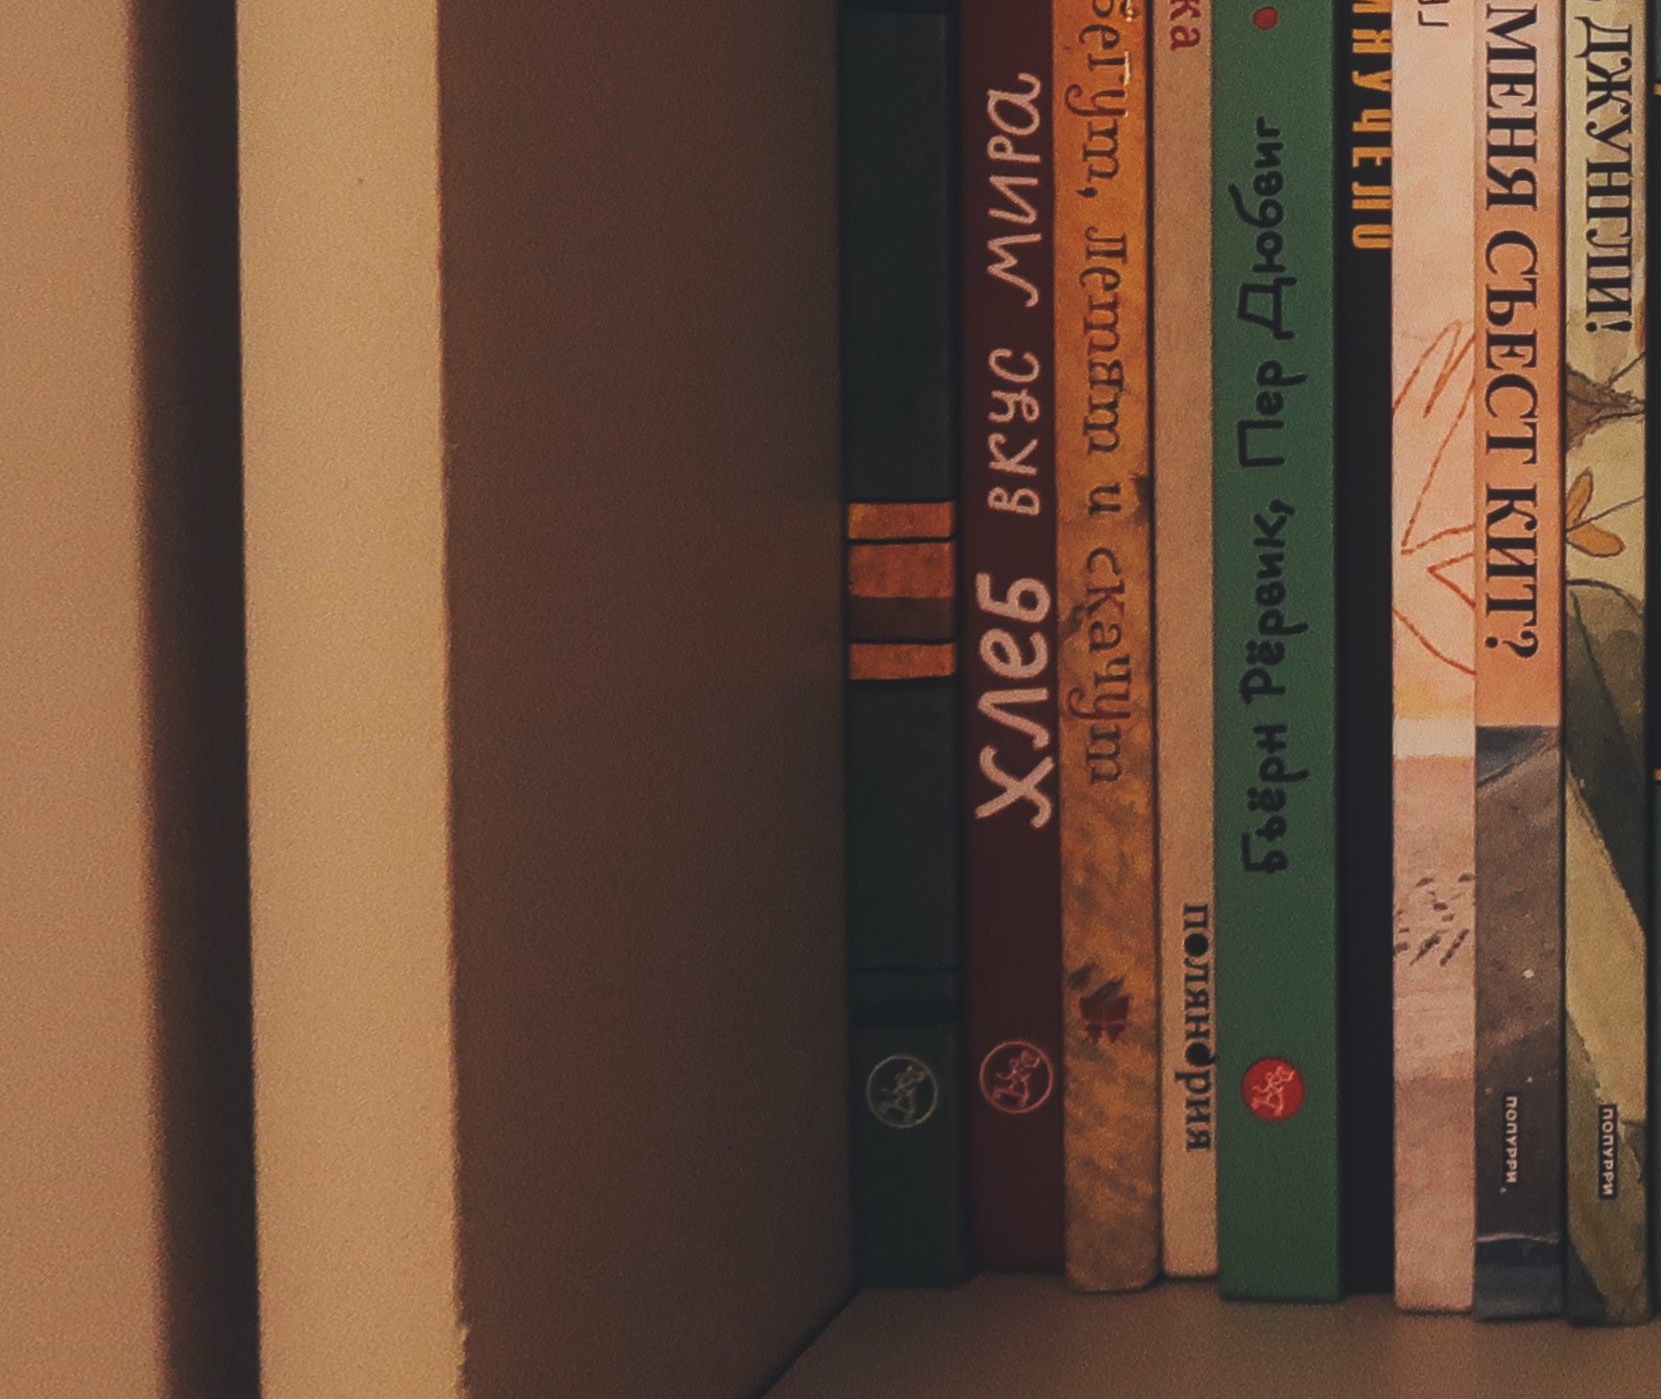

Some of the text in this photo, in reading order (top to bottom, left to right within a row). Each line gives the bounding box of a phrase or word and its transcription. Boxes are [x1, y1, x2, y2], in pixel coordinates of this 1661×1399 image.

[1487, 7, 1536, 210] МЕНЯ
[1578, 17, 1632, 332] ДЖУНГЛИ!
[1485, 231, 1537, 464] СЪЕСТ
[1228, 117, 1308, 874] Бьёрн Рёрвик, Пер Дюбвиг
[1486, 487, 1538, 658] КИТ?
[1600, 1107, 1617, 1197] ПОПУРРИ
